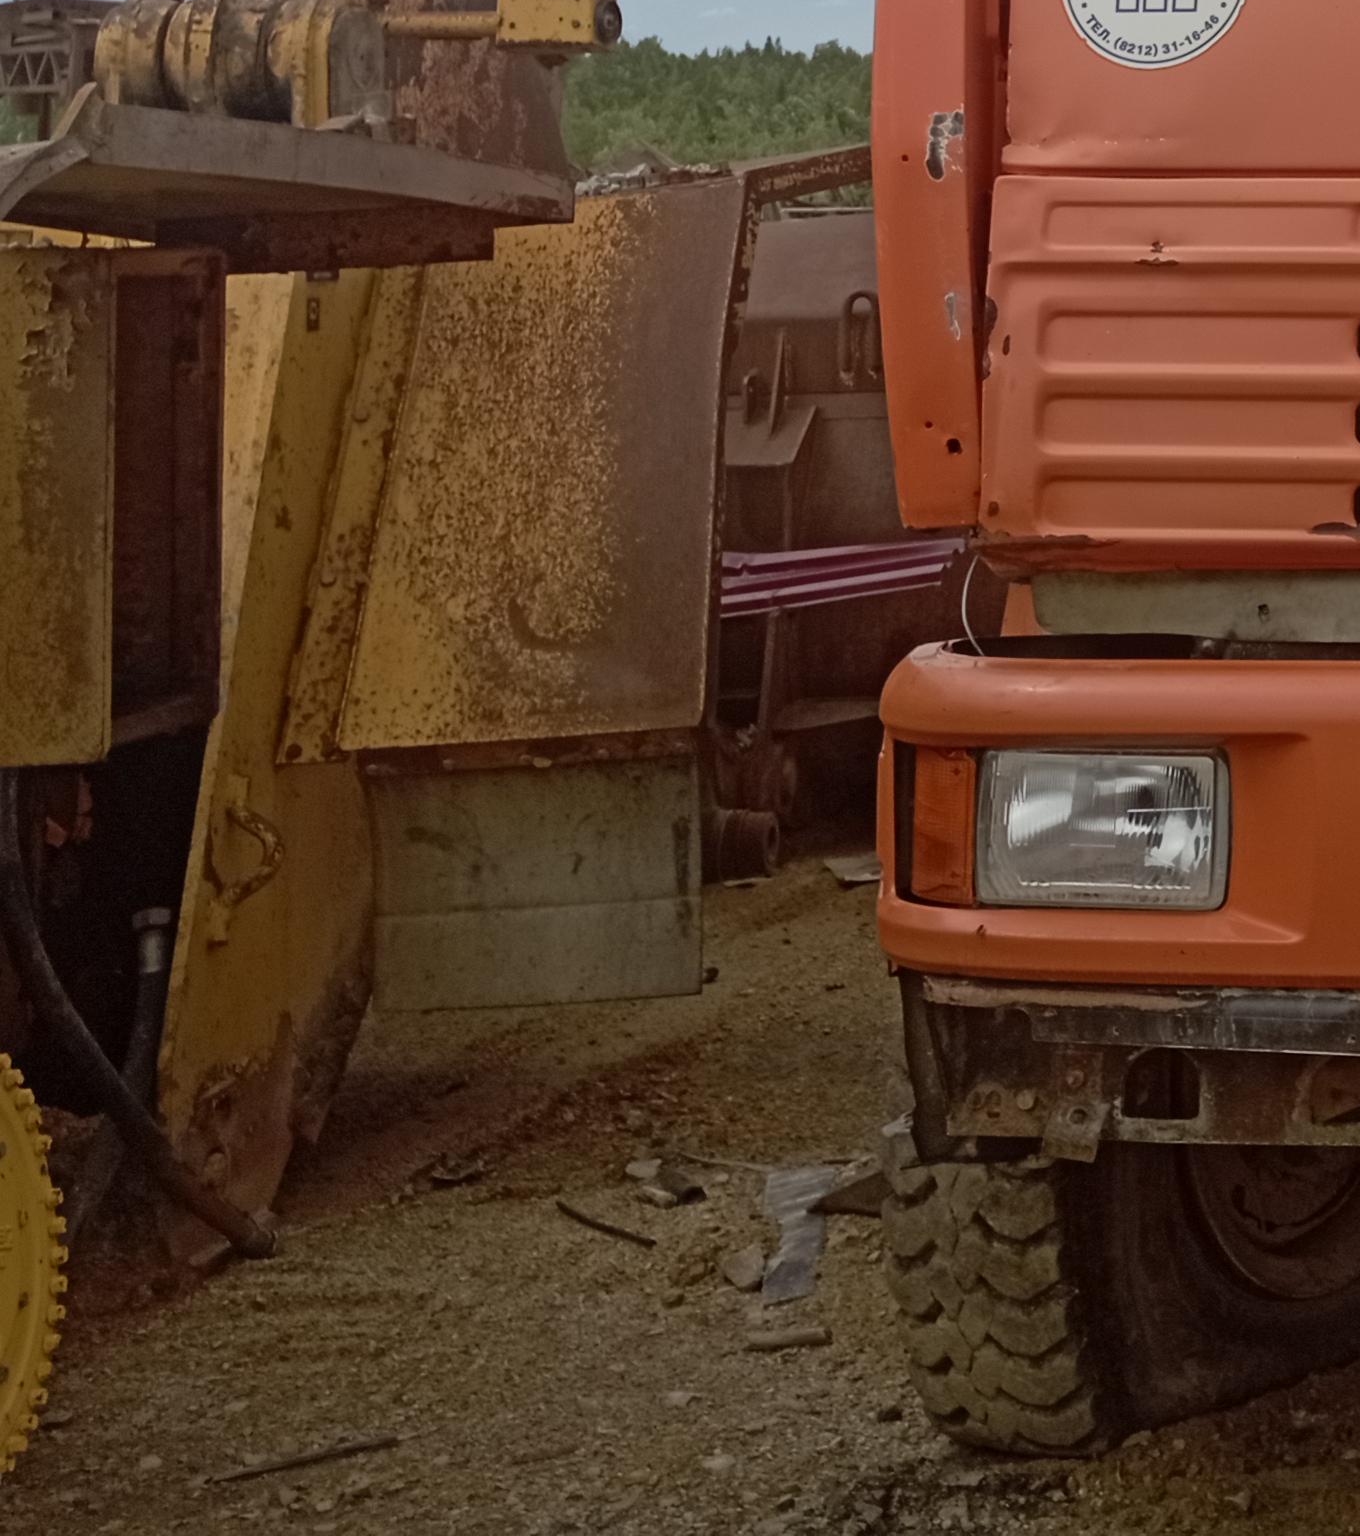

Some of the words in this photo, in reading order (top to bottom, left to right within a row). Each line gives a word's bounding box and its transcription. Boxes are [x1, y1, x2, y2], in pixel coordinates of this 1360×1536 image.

[1086, 14, 1111, 44] ТЕЛ.
[1113, 36, 1158, 57] (8212)
[1162, 14, 1220, 55] 31-16-46
